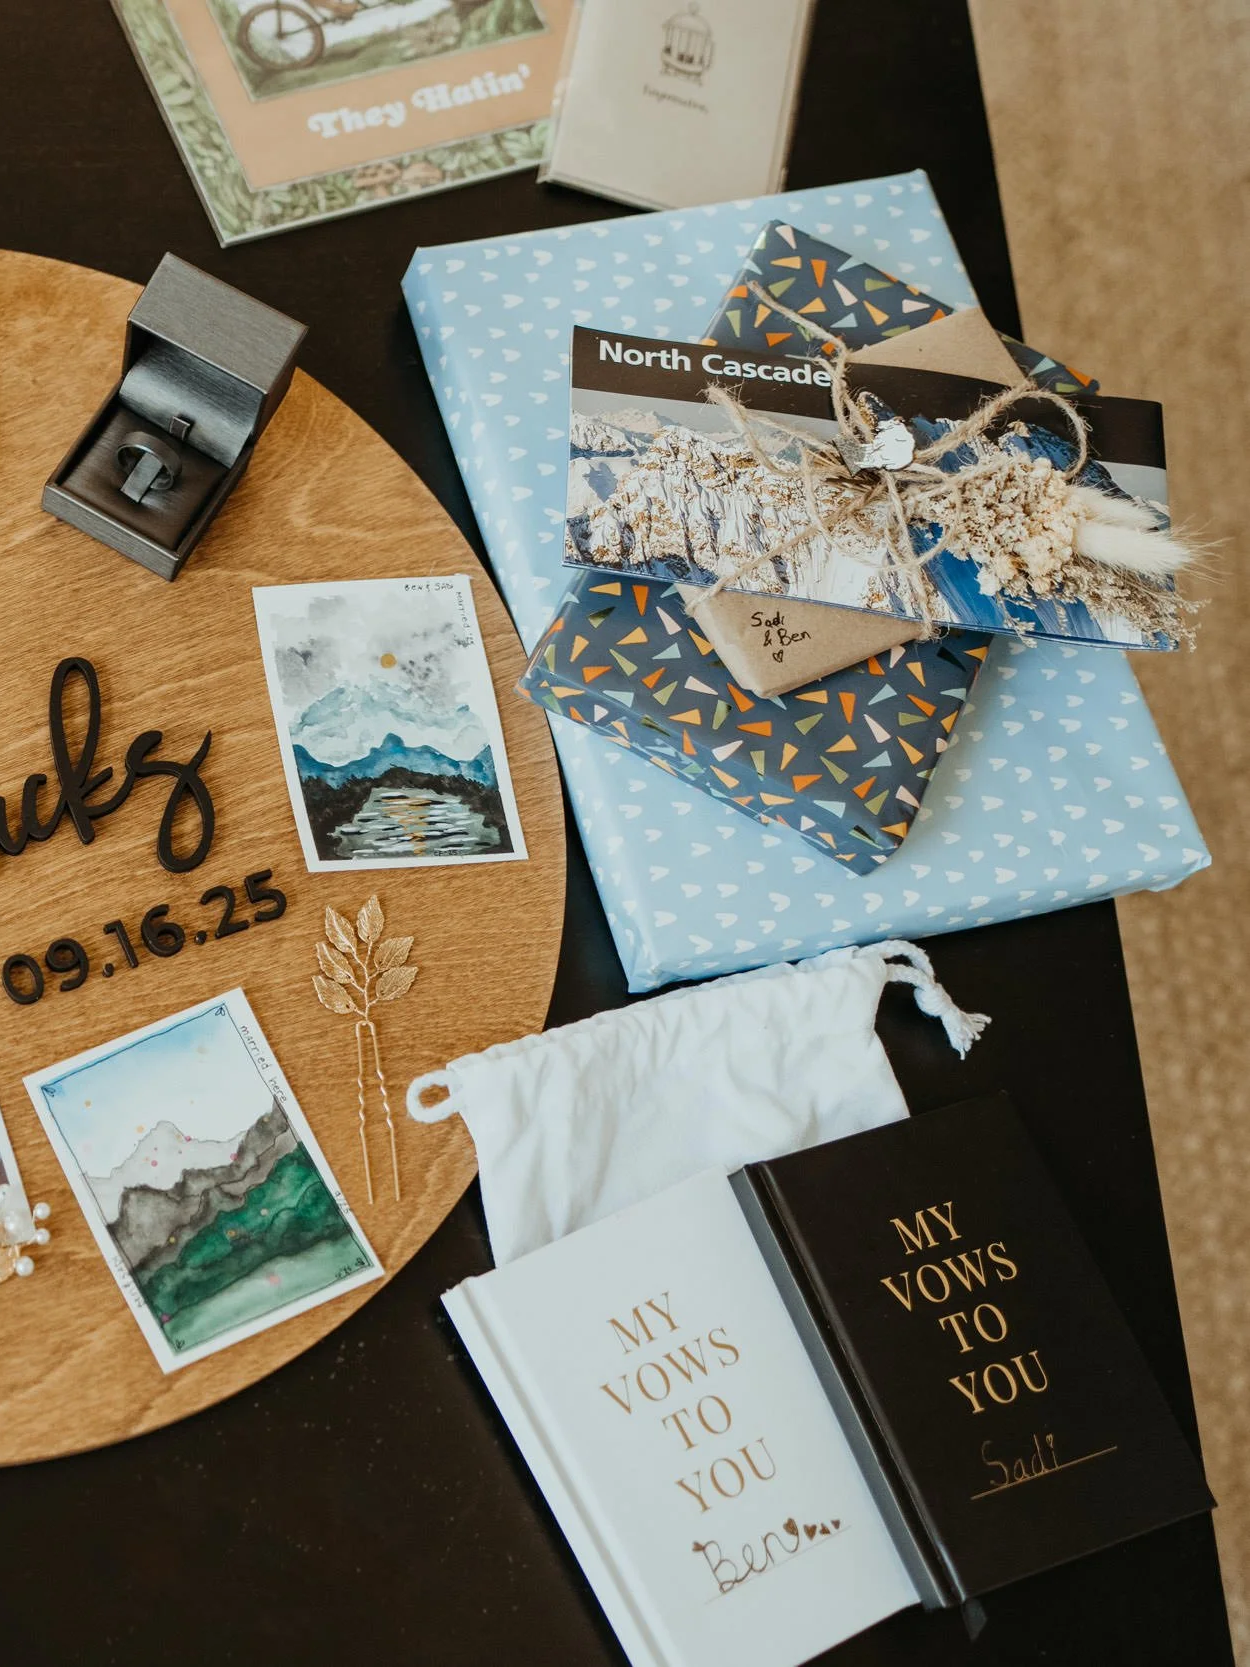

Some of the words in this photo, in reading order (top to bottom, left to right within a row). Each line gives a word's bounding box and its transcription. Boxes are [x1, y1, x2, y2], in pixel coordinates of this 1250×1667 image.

[307, 101, 407, 140] They
[410, 64, 532, 114] Hatin'
[598, 339, 692, 373] North
[701, 353, 832, 388] Cascade
[751, 611, 785, 628] Sadi
[763, 629, 773, 647] &
[777, 628, 812, 646] Ben
[2, 869, 288, 1005] 09.16.25
[267, 1076, 288, 1105] here
[890, 1200, 964, 1256] MY
[880, 1240, 1020, 1314] VOWS
[607, 1291, 682, 1355] MY
[938, 1302, 1009, 1355] TO
[599, 1326, 742, 1419] VOWS
[949, 1350, 1050, 1415] YOU
[661, 1394, 735, 1453] TO
[674, 1436, 779, 1515] YOU
[981, 1433, 1061, 1488] Sadi
[698, 1518, 800, 1594] Ben
